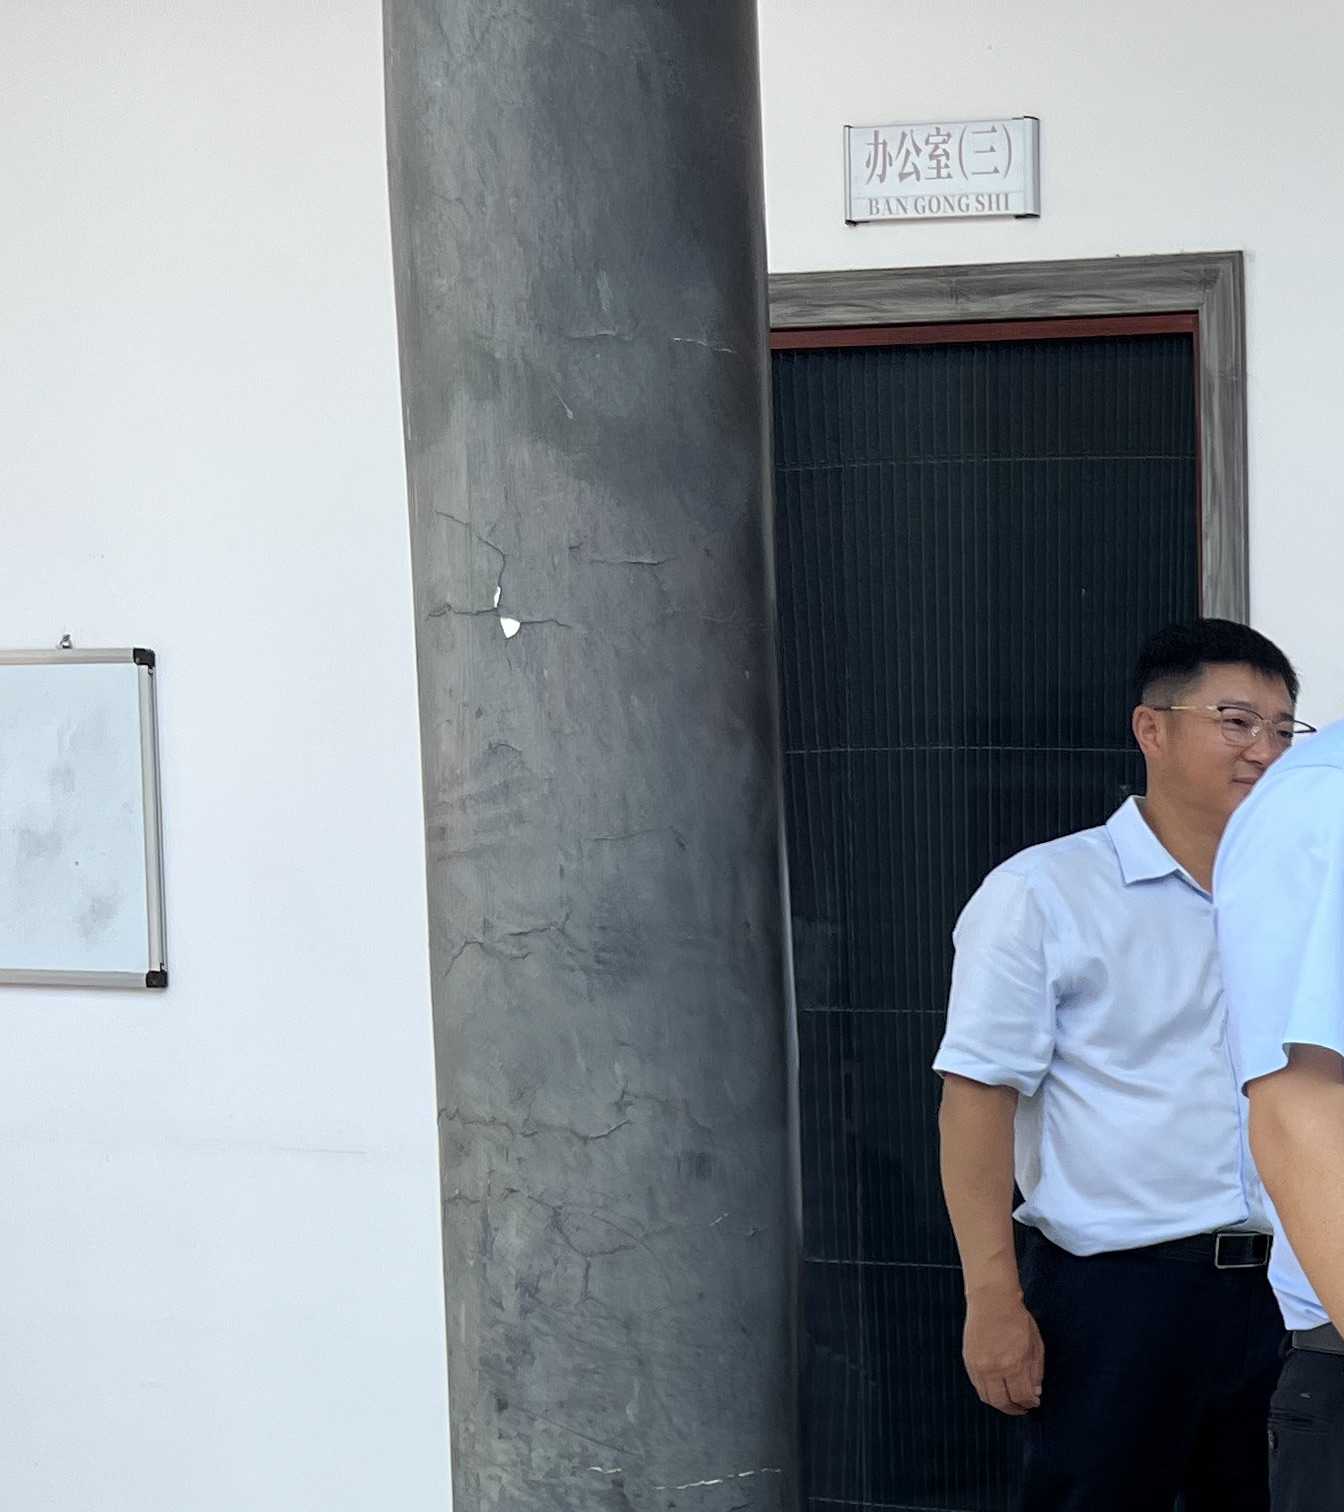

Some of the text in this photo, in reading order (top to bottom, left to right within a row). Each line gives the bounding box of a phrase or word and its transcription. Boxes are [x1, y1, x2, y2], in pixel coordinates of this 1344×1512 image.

[865, 124, 1012, 185] 办公室(三)
[868, 192, 1010, 216] BAN GONG SHI
